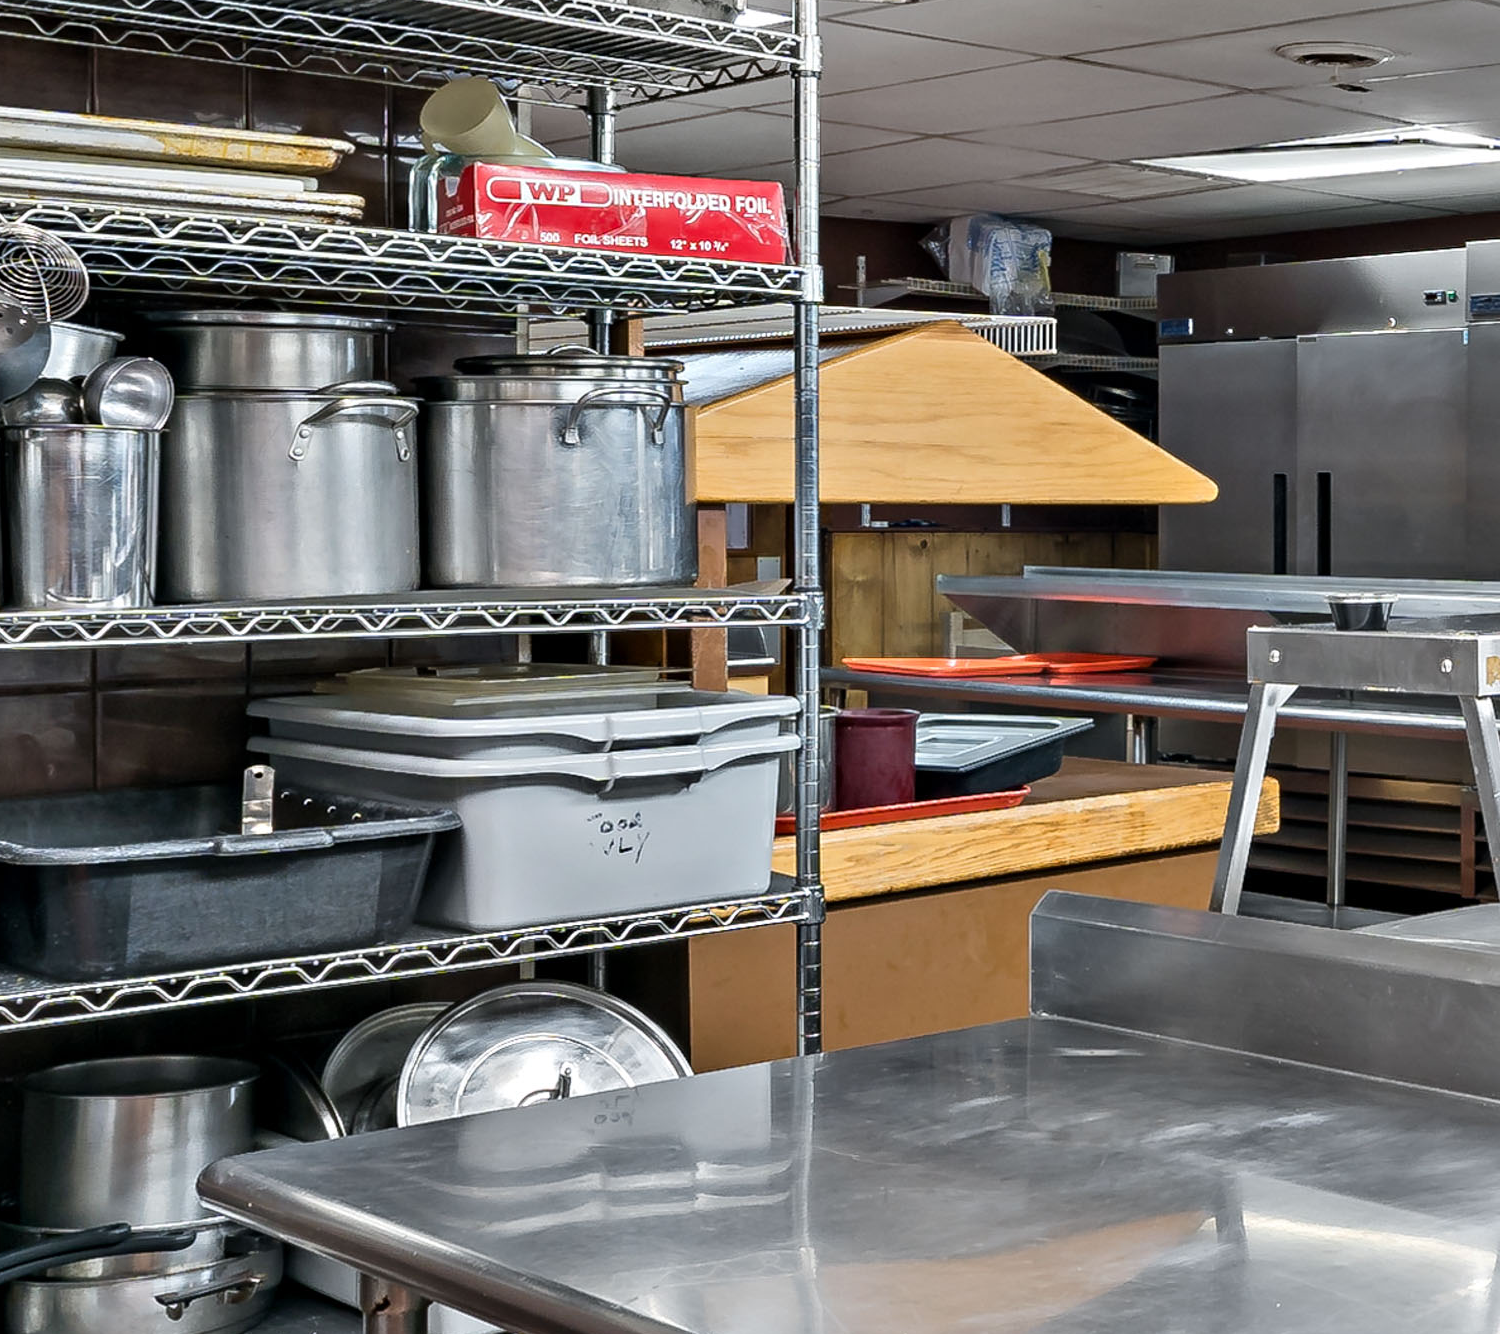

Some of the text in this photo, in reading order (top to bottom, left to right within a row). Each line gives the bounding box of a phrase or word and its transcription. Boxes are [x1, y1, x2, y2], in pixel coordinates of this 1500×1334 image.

[526, 182, 575, 203] WP
[613, 188, 731, 213] INTERFOLDED
[540, 232, 561, 244] 500
[574, 233, 600, 245] FOIL
[603, 235, 649, 248] SHEETS
[700, 240, 712, 251] 10
